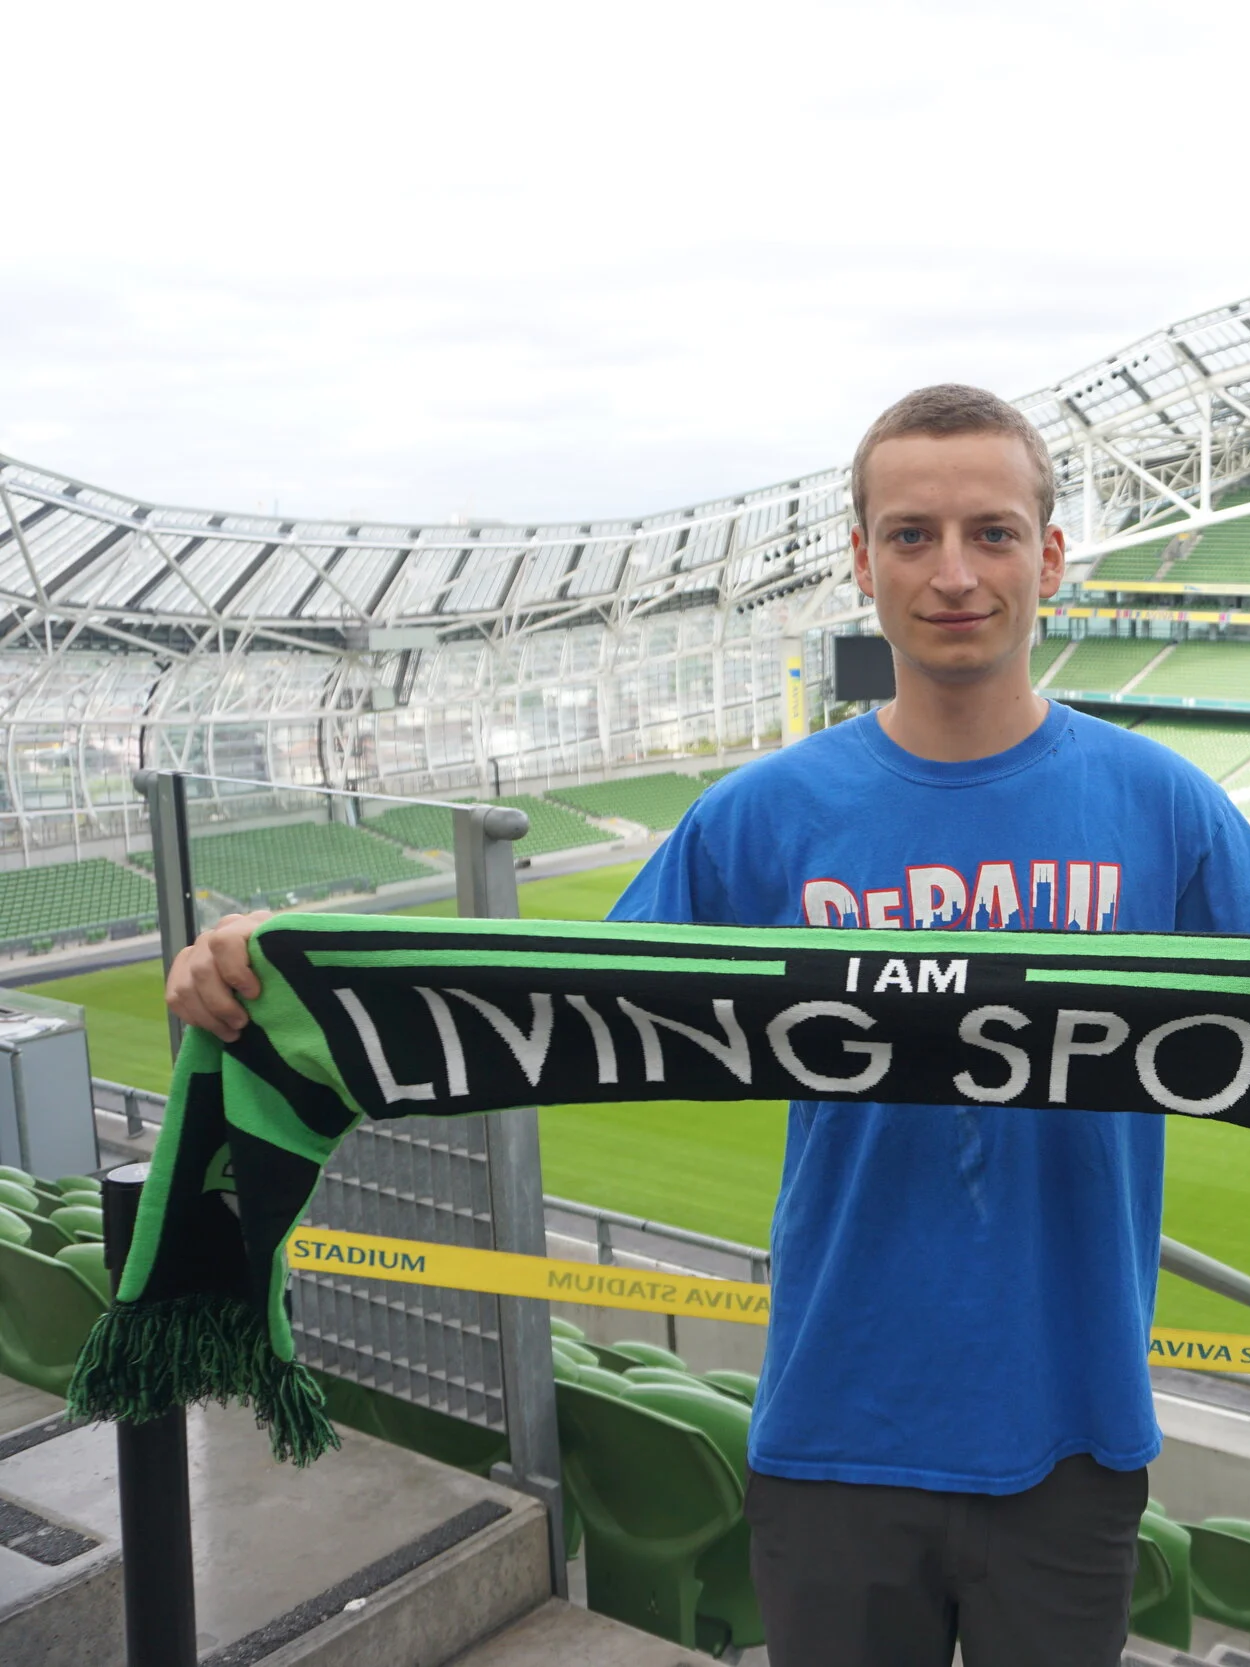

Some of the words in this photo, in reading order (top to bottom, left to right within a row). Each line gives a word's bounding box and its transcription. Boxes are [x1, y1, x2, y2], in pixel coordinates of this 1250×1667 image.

[846, 957, 861, 992] I
[873, 958, 969, 994] AM
[333, 987, 893, 1103] LIVING
[294, 1240, 426, 1273] STADIUM
[1148, 1339, 1232, 1362] AVIVA
